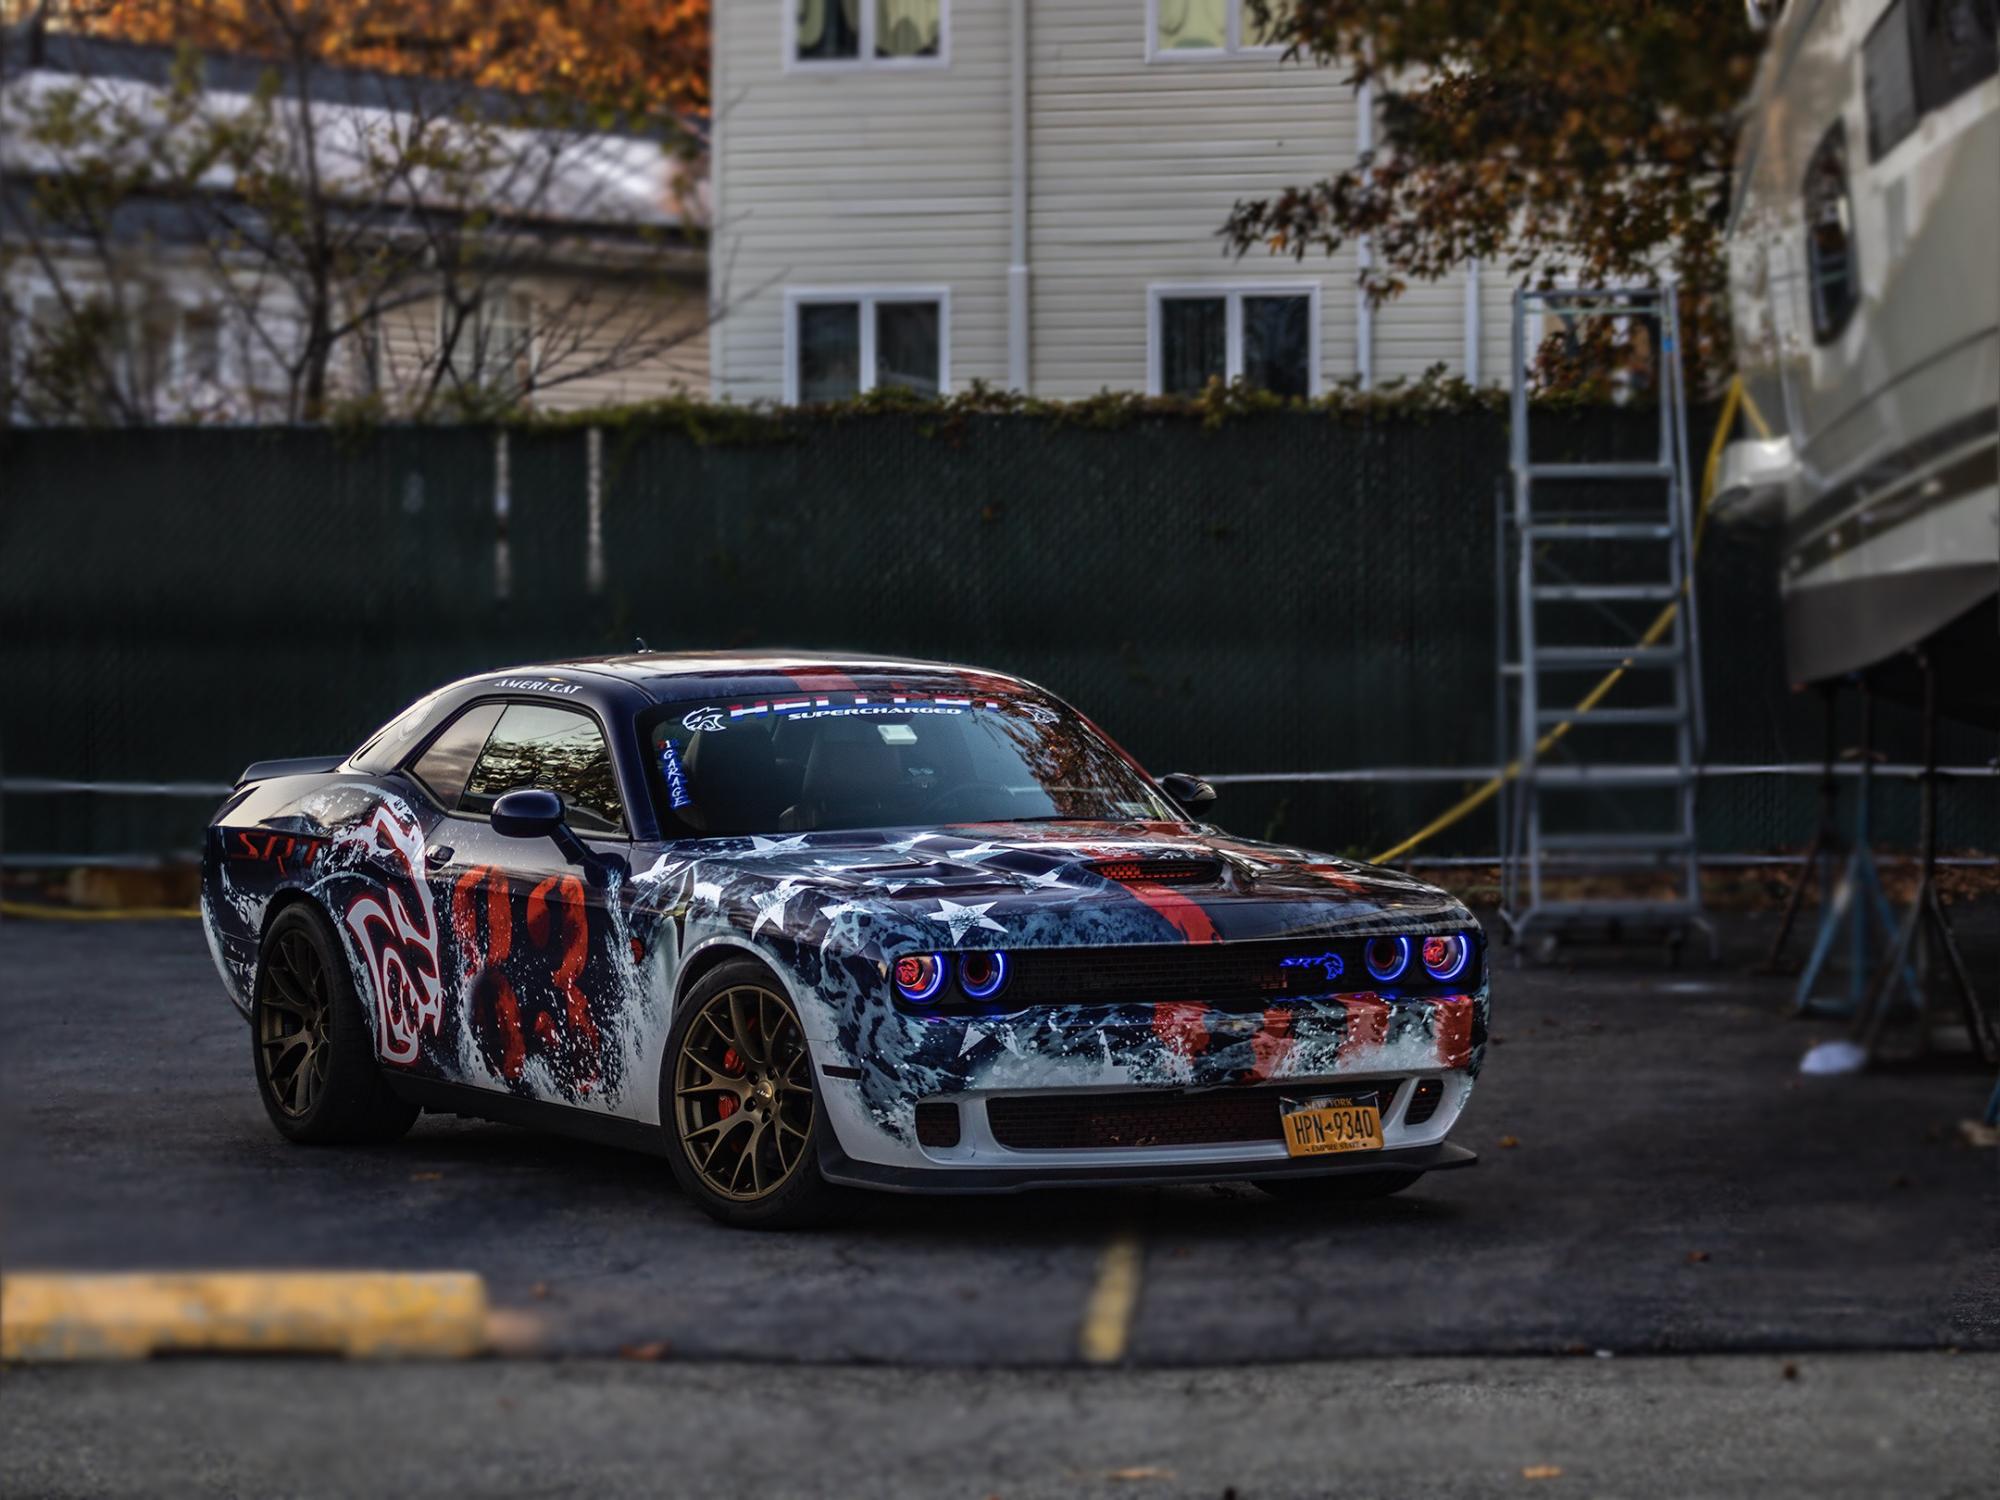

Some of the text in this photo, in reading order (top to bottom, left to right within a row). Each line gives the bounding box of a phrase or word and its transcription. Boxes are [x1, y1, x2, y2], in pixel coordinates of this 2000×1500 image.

[788, 706, 963, 721] SUPERCHARGED
[663, 749, 688, 807] GARAGE
[230, 832, 334, 879] SRT
[1328, 1097, 1353, 1107] YORK
